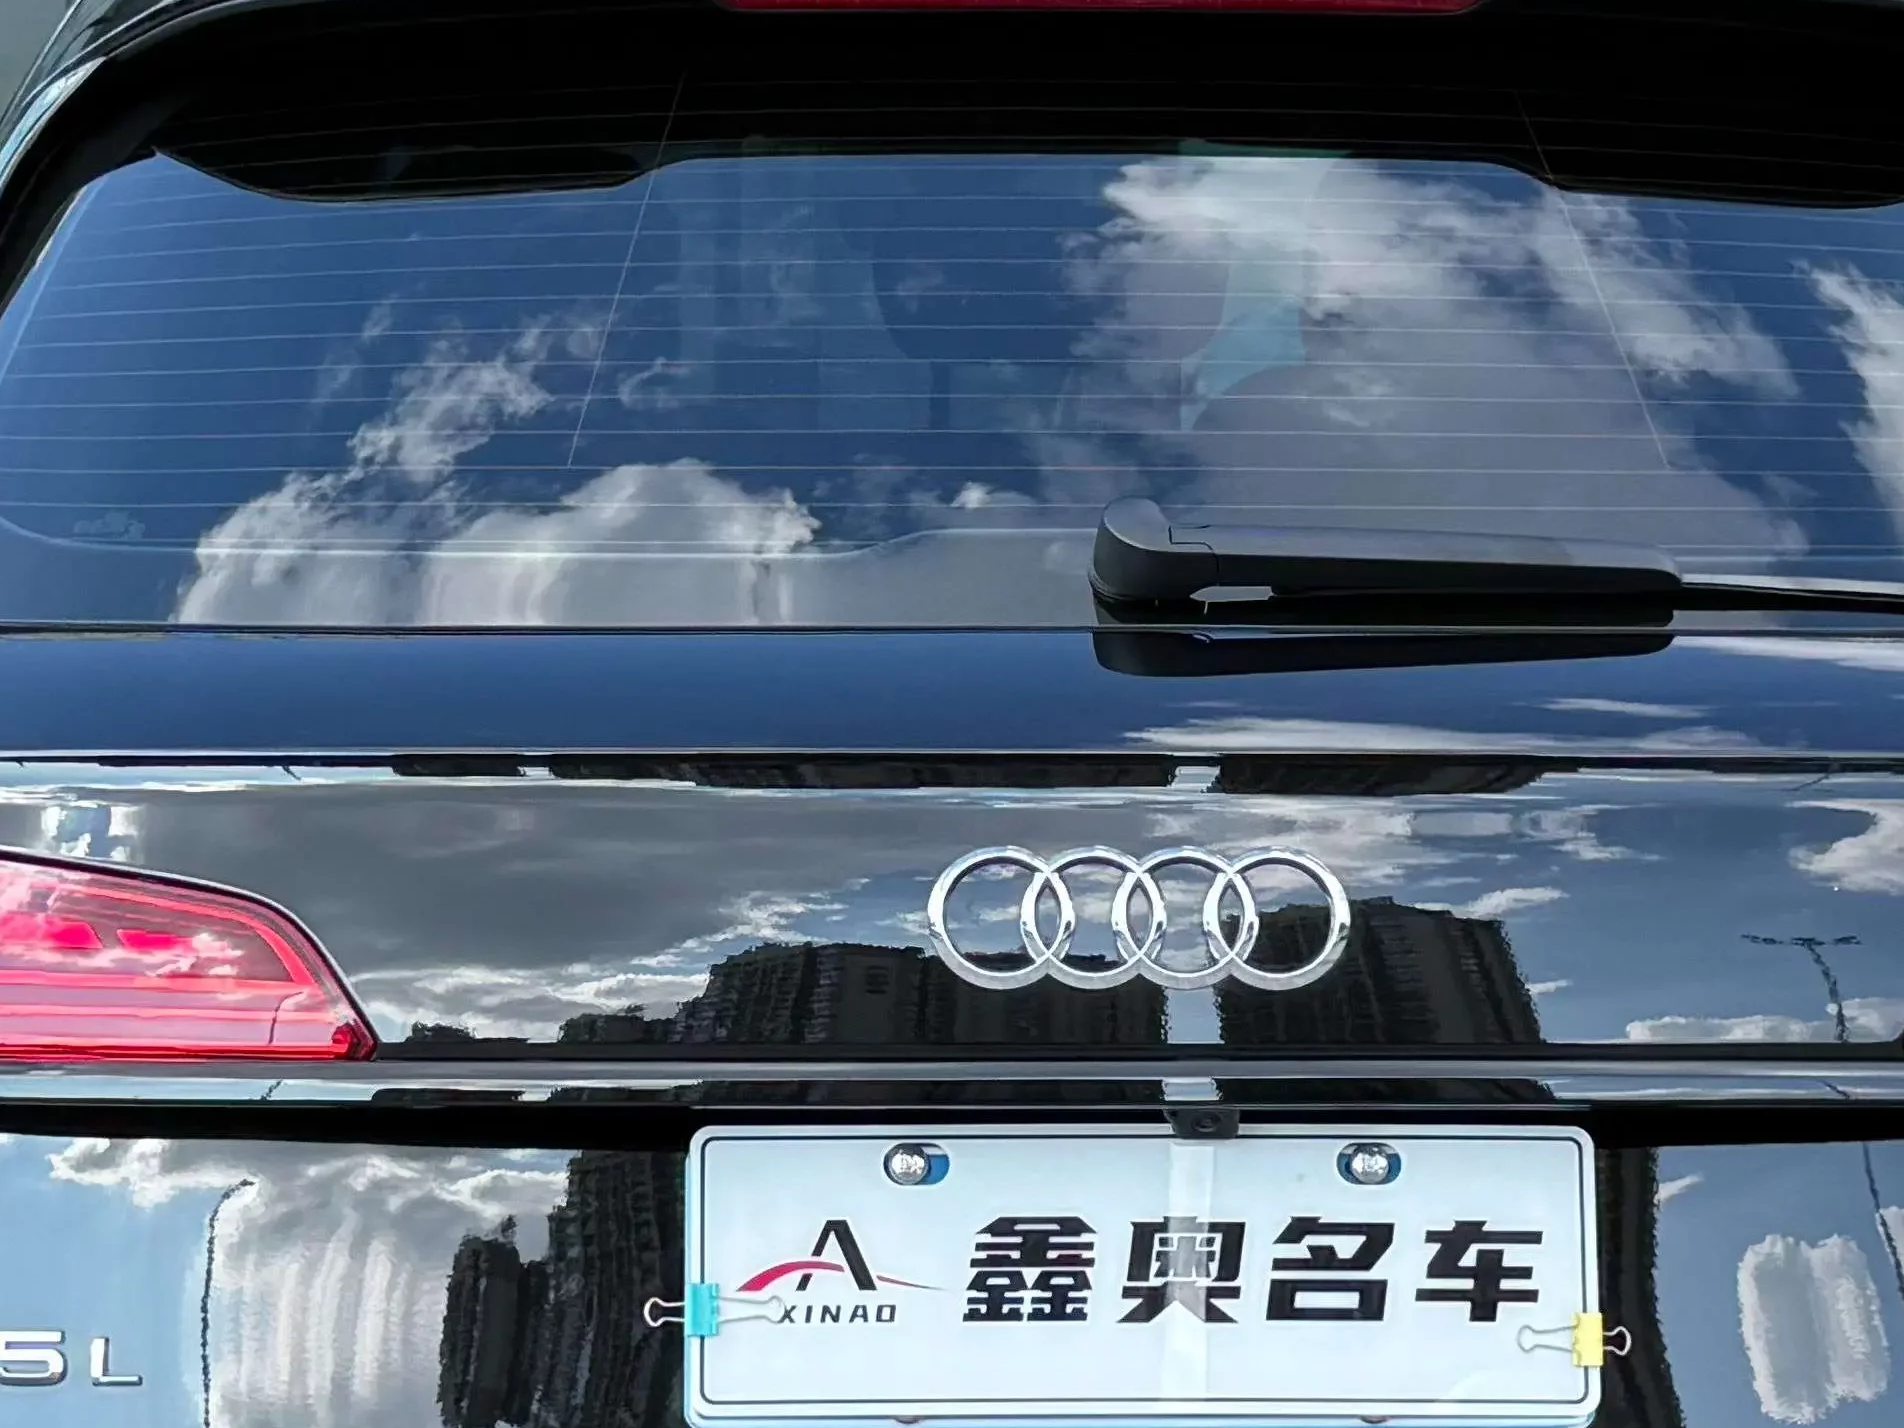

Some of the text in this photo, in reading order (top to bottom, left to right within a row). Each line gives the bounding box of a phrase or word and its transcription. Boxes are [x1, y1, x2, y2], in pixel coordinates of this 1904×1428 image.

[962, 1215, 1544, 1324] 鑫奥名车
[777, 1304, 897, 1324] XINAO
